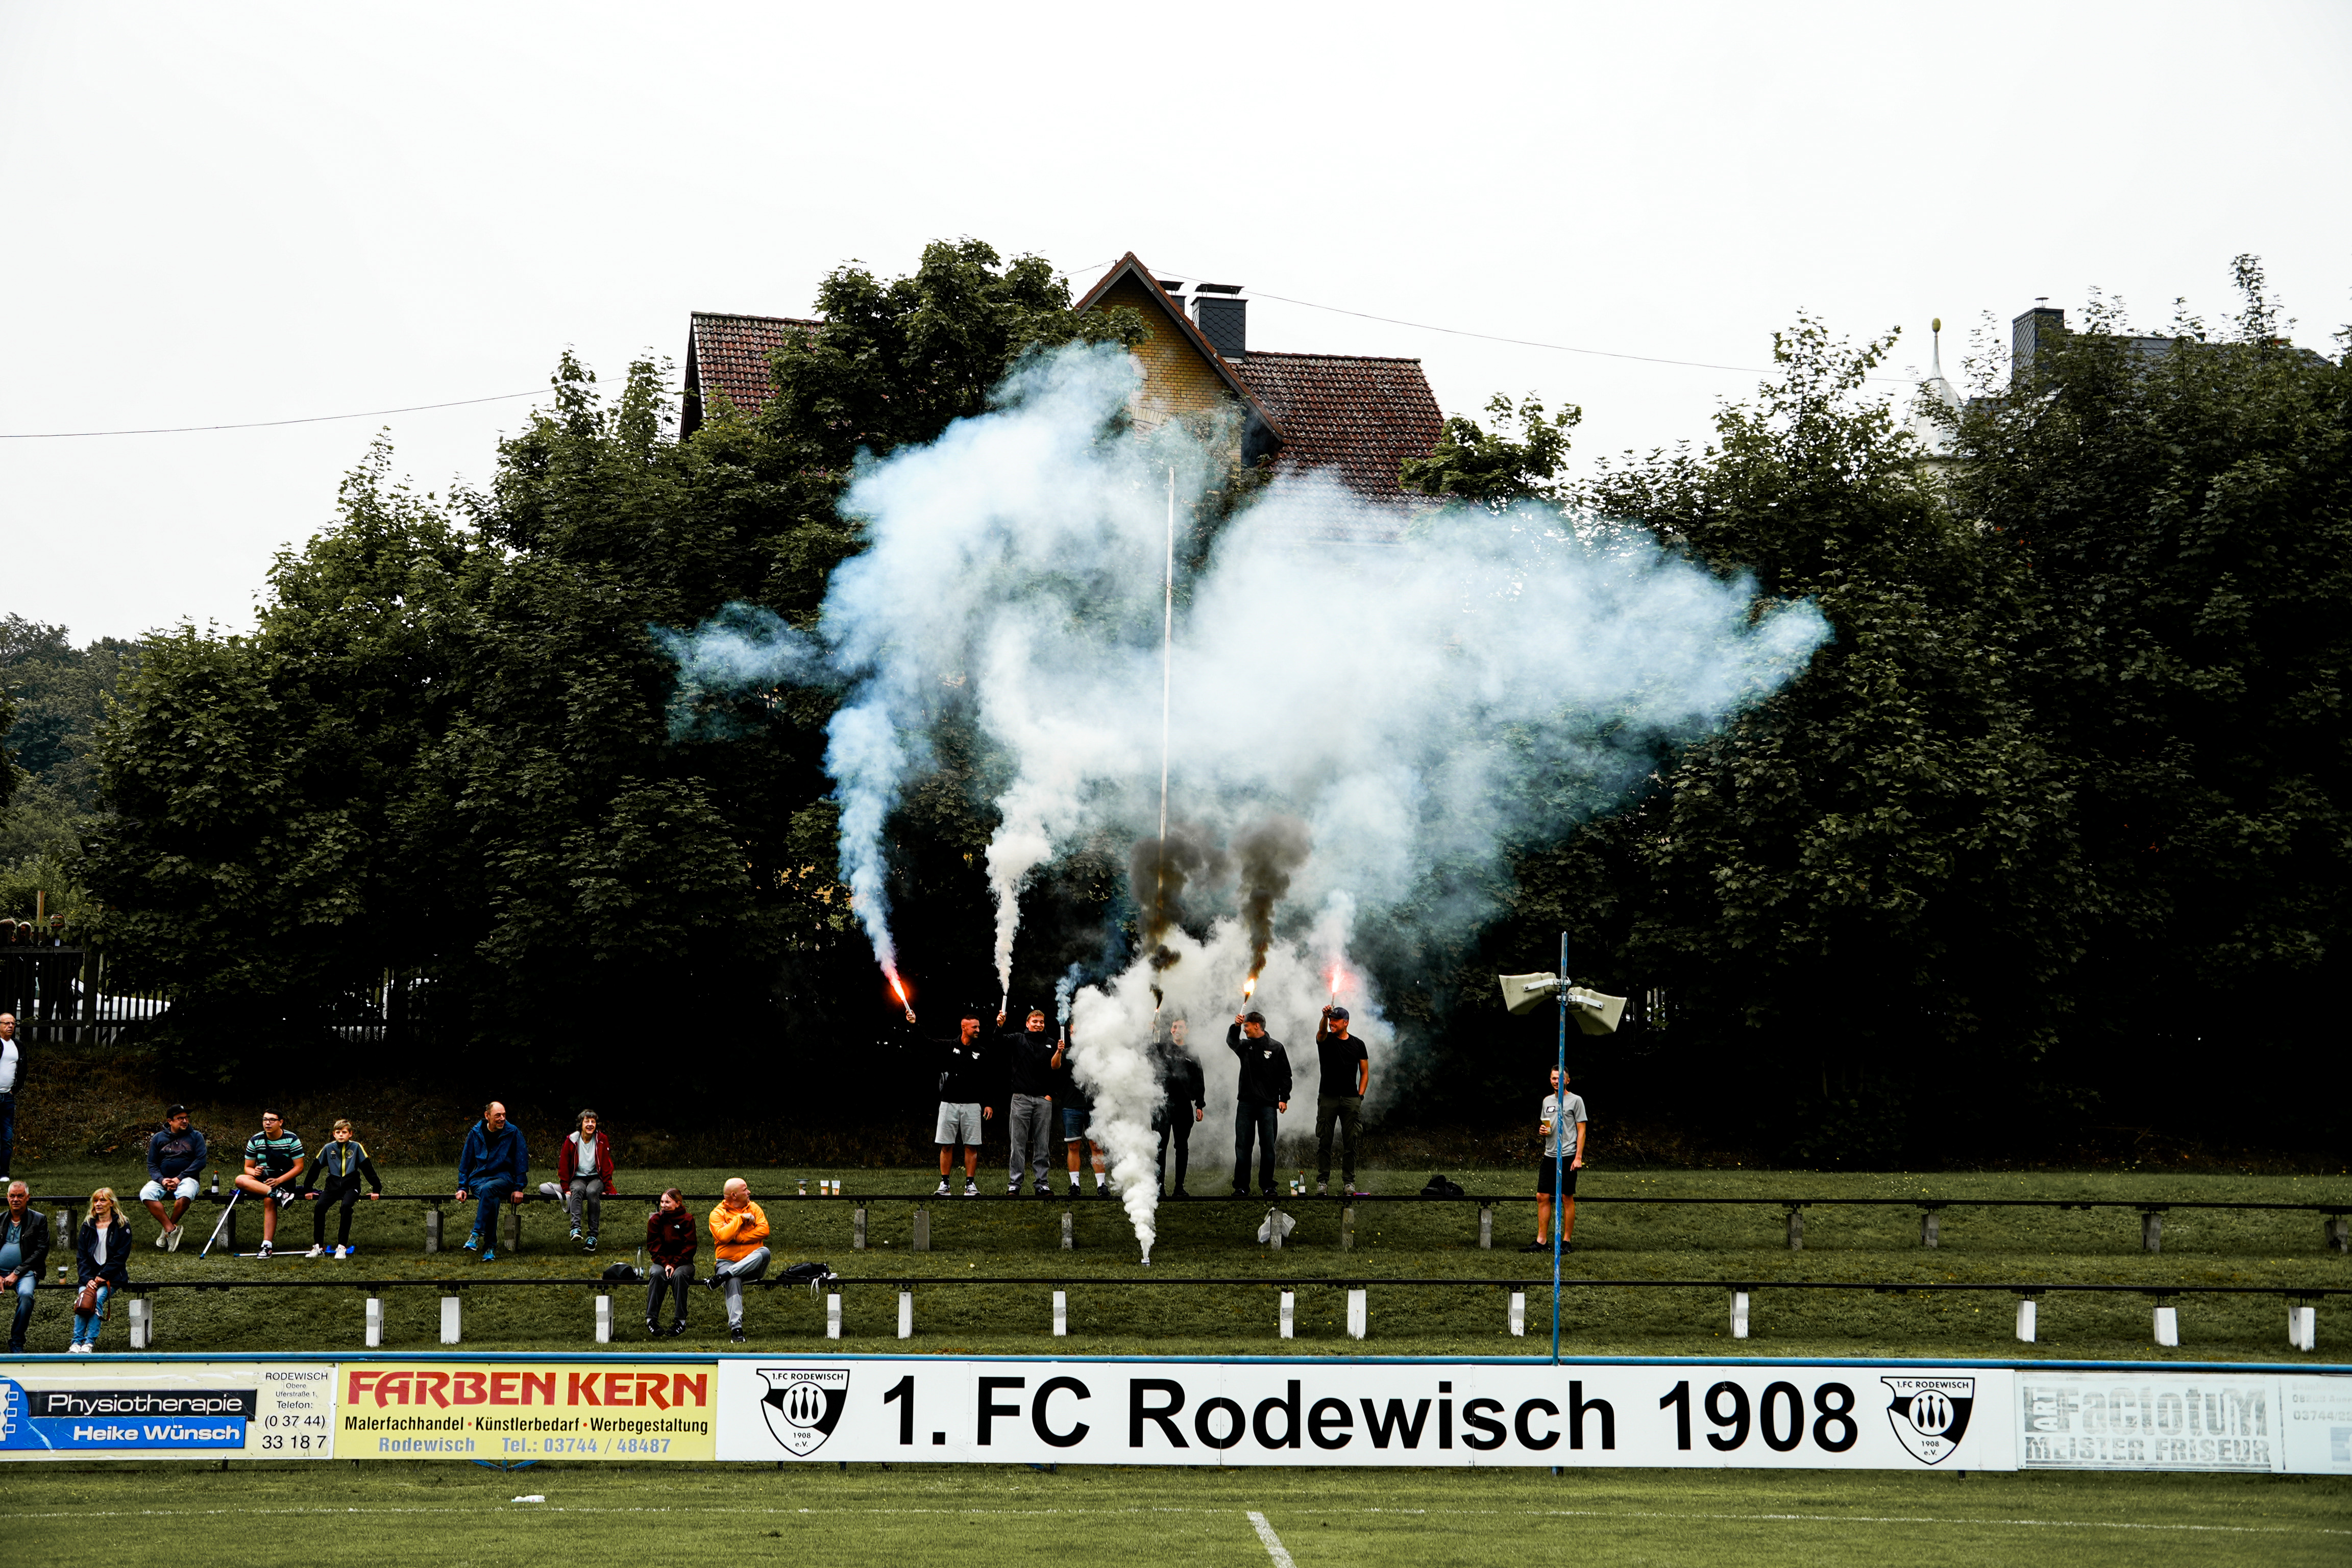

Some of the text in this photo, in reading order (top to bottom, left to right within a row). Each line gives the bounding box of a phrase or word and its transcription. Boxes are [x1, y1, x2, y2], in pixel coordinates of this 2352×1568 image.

[265, 1372, 328, 1381] RODEWISCH
[348, 1371, 707, 1411] FARBEN KERN
[48, 1393, 242, 1416] Physiotherapie
[277, 1401, 313, 1409] Telefon:
[265, 1415, 325, 1430] (0 37 44)
[884, 1376, 1858, 1453] 1. FC Rodewisch 1908
[74, 1424, 239, 1440] Heike Wünsch
[345, 1416, 708, 1435] Malerfachhandel Künstlerbedarf Werbegestaltung
[262, 1435, 283, 1449] 33
[379, 1438, 475, 1452] Rodewisch
[502, 1437, 538, 1452] Tel.:
[544, 1438, 597, 1453] 03744
[617, 1439, 671, 1453] 48487
[2025, 1437, 2269, 1463] MEISTER FRISEUR
